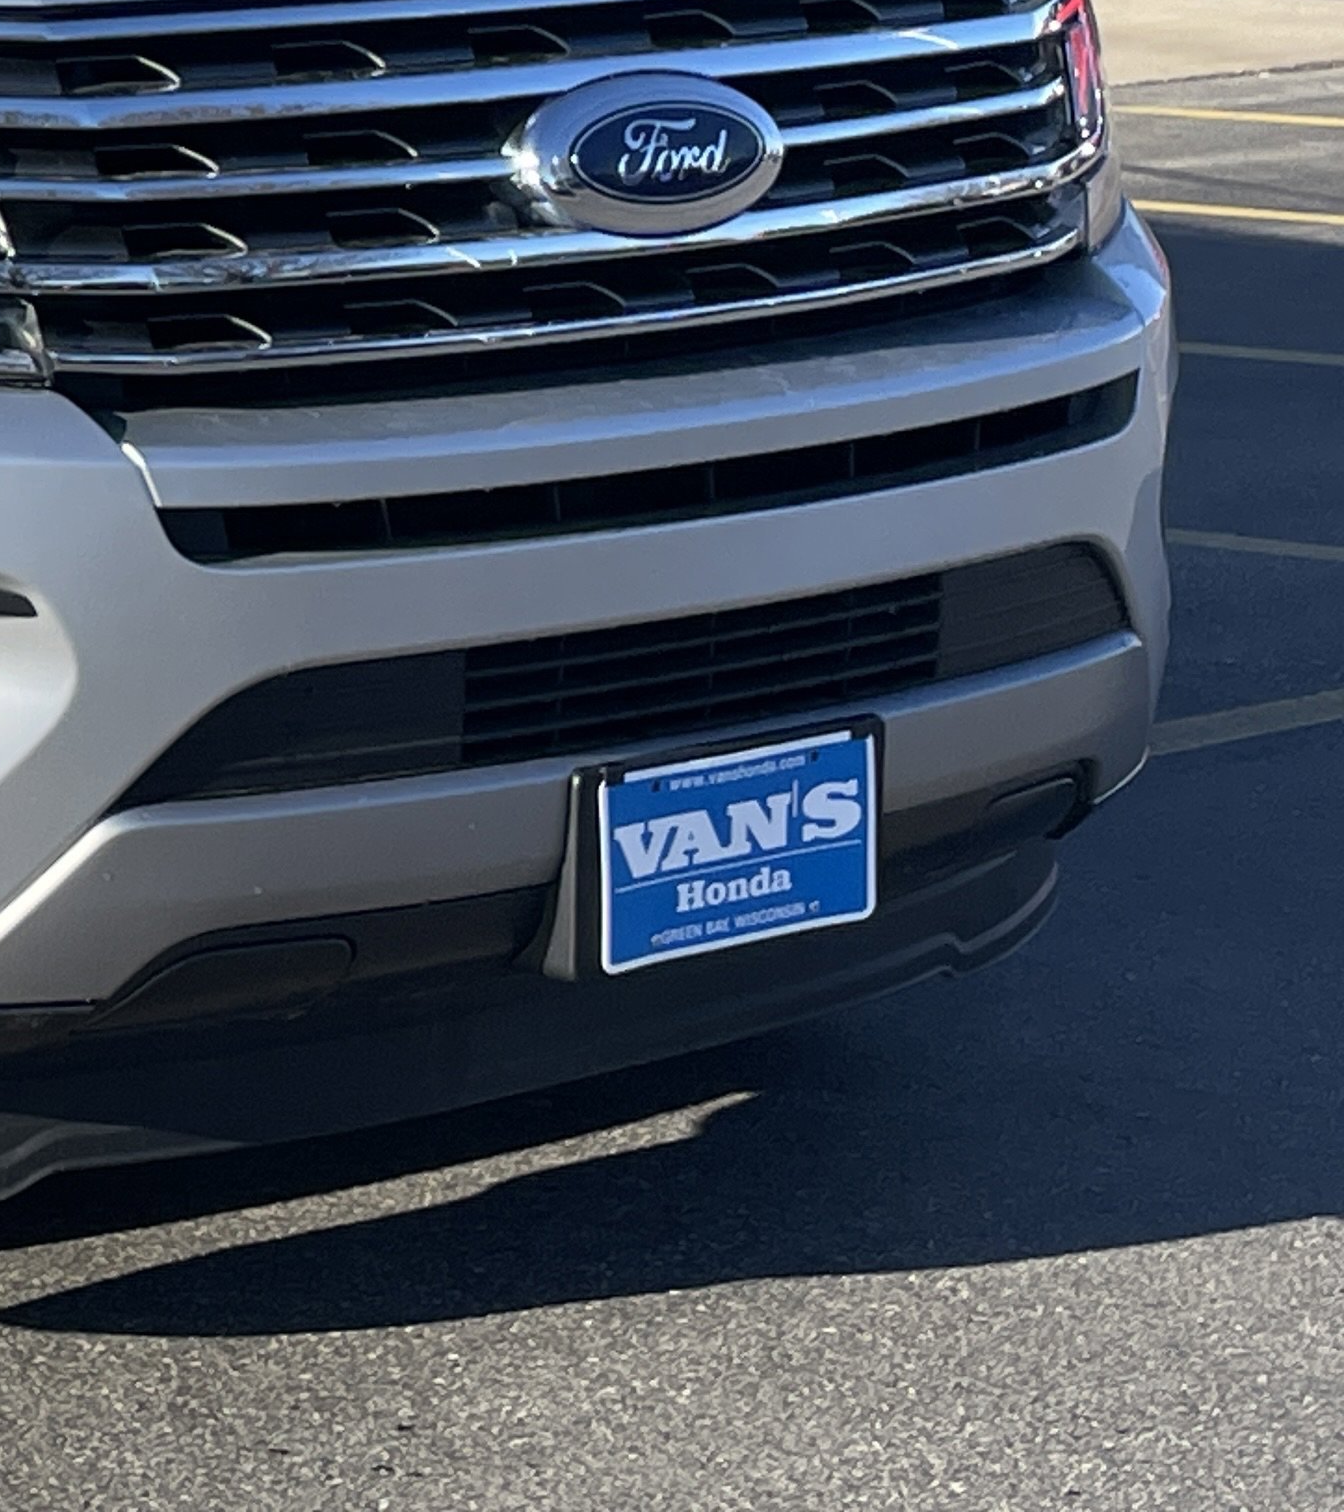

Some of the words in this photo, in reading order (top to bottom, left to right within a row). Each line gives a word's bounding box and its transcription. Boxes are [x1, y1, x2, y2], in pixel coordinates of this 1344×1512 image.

[618, 118, 730, 186] Ford
[613, 778, 863, 879] VAN'S
[676, 866, 792, 913] Honda
[734, 900, 806, 927] WISCONSIN
